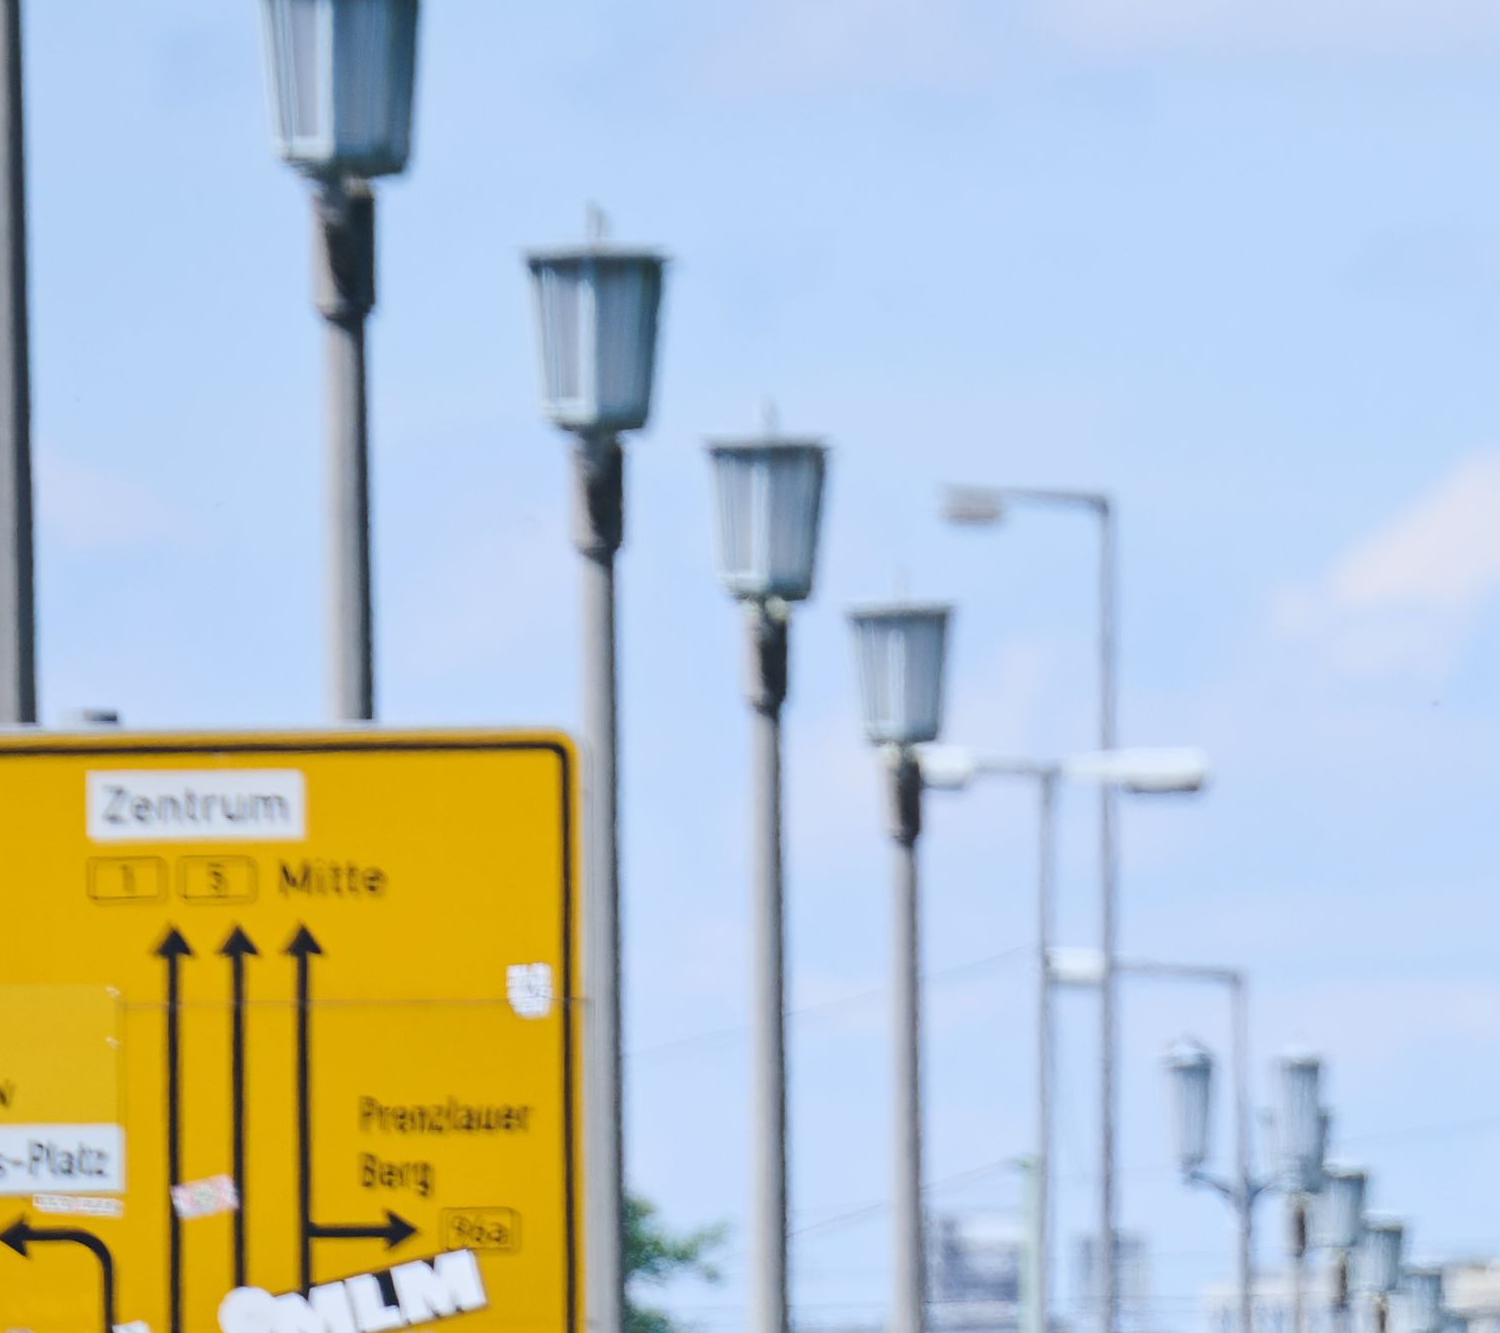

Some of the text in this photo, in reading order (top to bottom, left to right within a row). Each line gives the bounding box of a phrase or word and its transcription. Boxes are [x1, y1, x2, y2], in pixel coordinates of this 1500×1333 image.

[102, 784, 290, 824] Zentrum
[278, 858, 387, 897] Mitte
[359, 1095, 532, 1133] Prenzlauer
[359, 1152, 434, 1199] Berg
